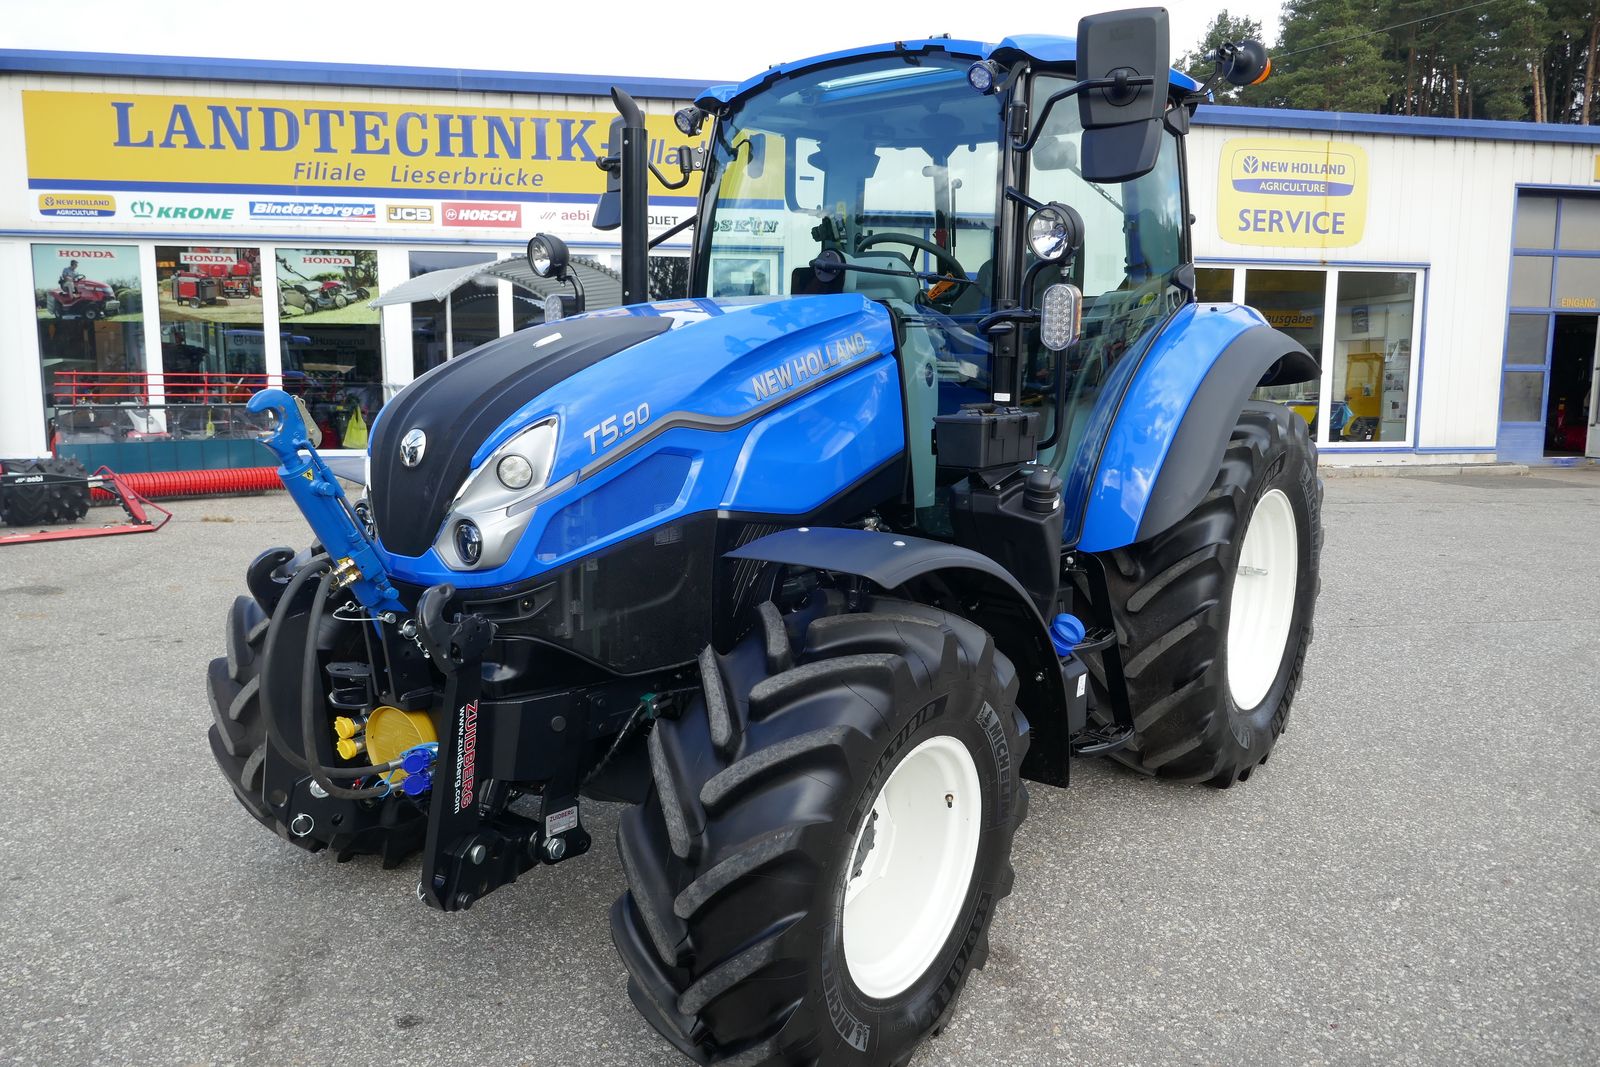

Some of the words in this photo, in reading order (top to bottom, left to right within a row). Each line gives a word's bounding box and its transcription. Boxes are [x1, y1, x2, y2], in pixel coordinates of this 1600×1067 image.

[293, 162, 366, 181] Filiale
[391, 165, 544, 187] Lieserbrücke
[1262, 161, 1288, 172] NEW
[1291, 162, 1346, 175] HOLLAND
[1259, 181, 1326, 193] AGRICULTURE
[75, 199, 110, 207] HOLLAND
[253, 201, 374, 217] Binderberger
[157, 206, 235, 220] KRONE
[389, 206, 432, 221] JCB
[458, 208, 517, 222] HORSCH
[561, 209, 591, 221] aebi
[648, 214, 679, 226] OLIET
[1238, 208, 1346, 235] SERVICE
[58, 249, 115, 259] HONDA
[183, 254, 234, 263] HONDA
[302, 256, 352, 265] HONDA
[1561, 298, 1596, 308] EINGANG
[1266, 312, 1313, 327] ausgabe
[751, 361, 794, 401] NEW
[796, 331, 868, 382] HOLLAND
[583, 402, 650, 455] T5.90
[454, 705, 466, 815] www.zuidberg.com
[461, 699, 479, 809] ZUIDBERG
